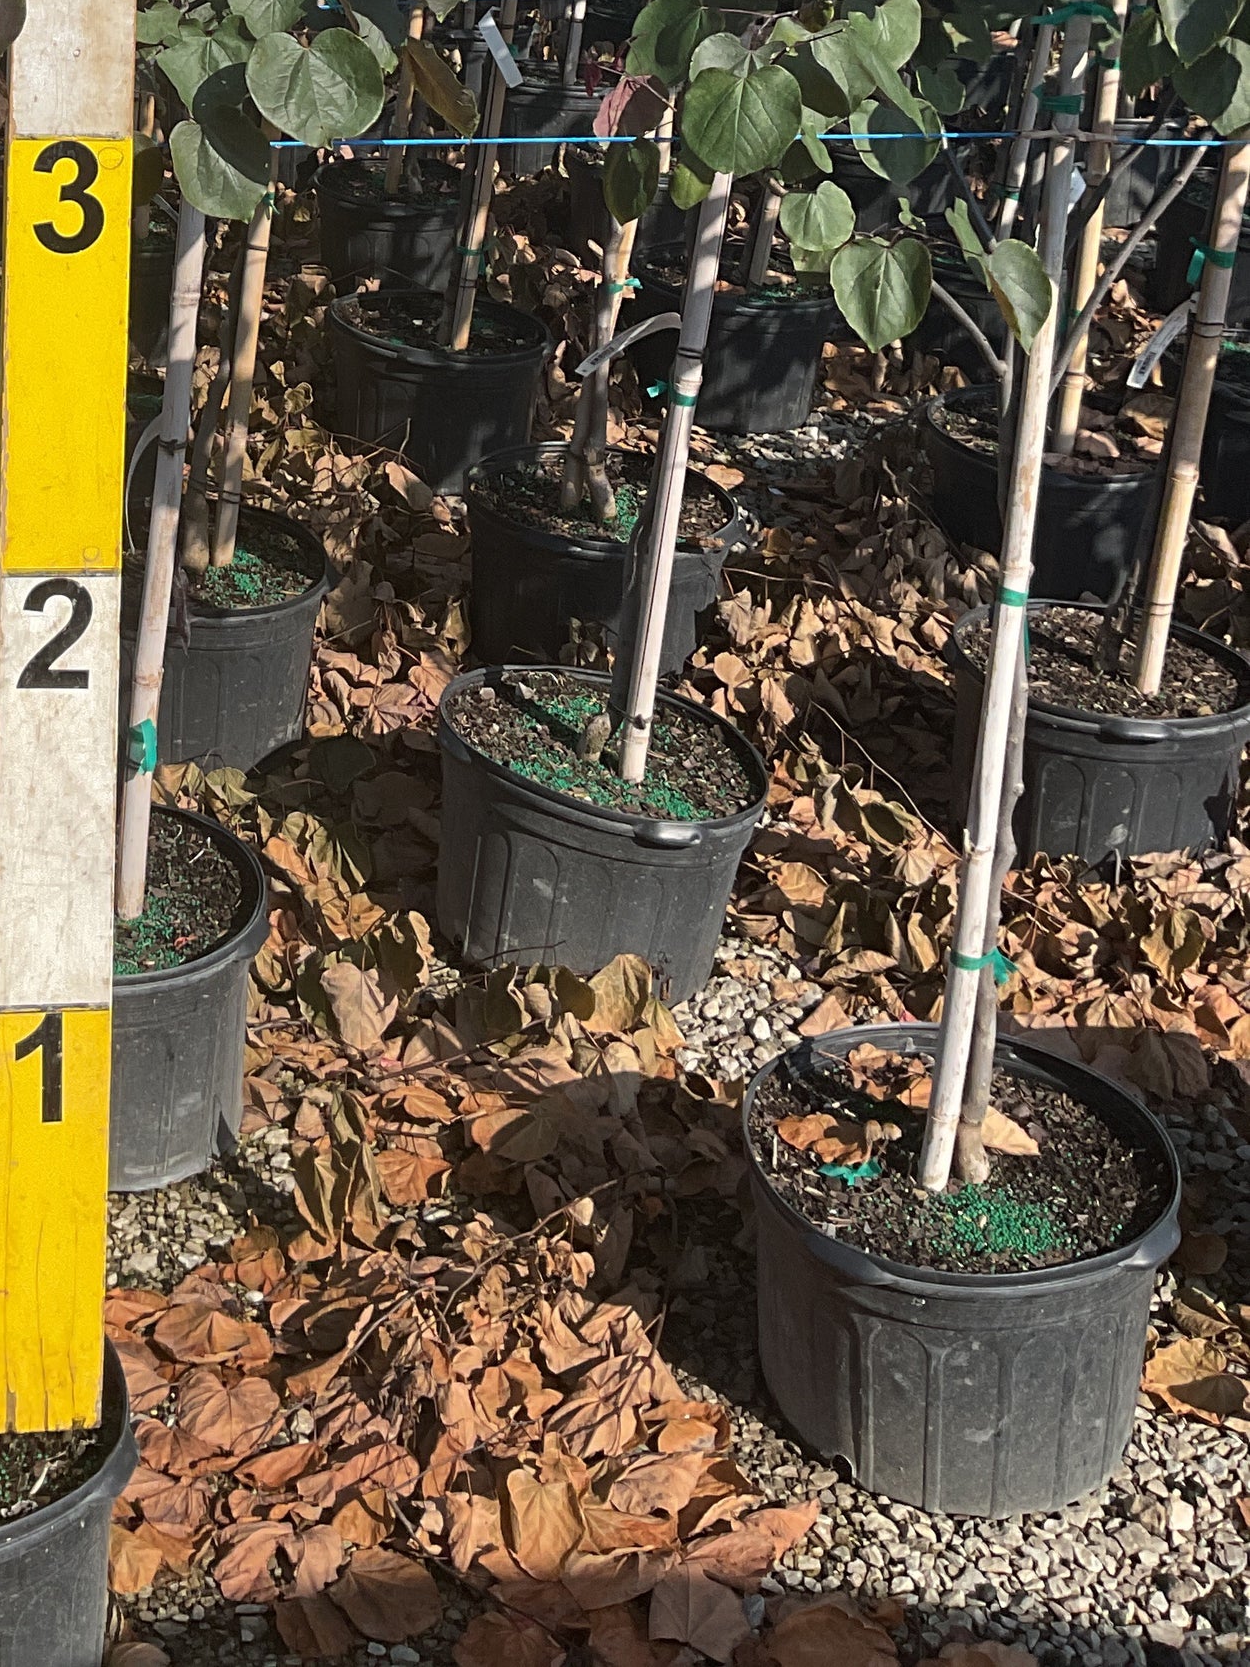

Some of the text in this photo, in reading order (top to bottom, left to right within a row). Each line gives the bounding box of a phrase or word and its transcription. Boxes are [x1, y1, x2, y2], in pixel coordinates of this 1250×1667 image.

[32, 141, 105, 255] 3
[15, 578, 93, 689] 2
[15, 1012, 63, 1123] 1
